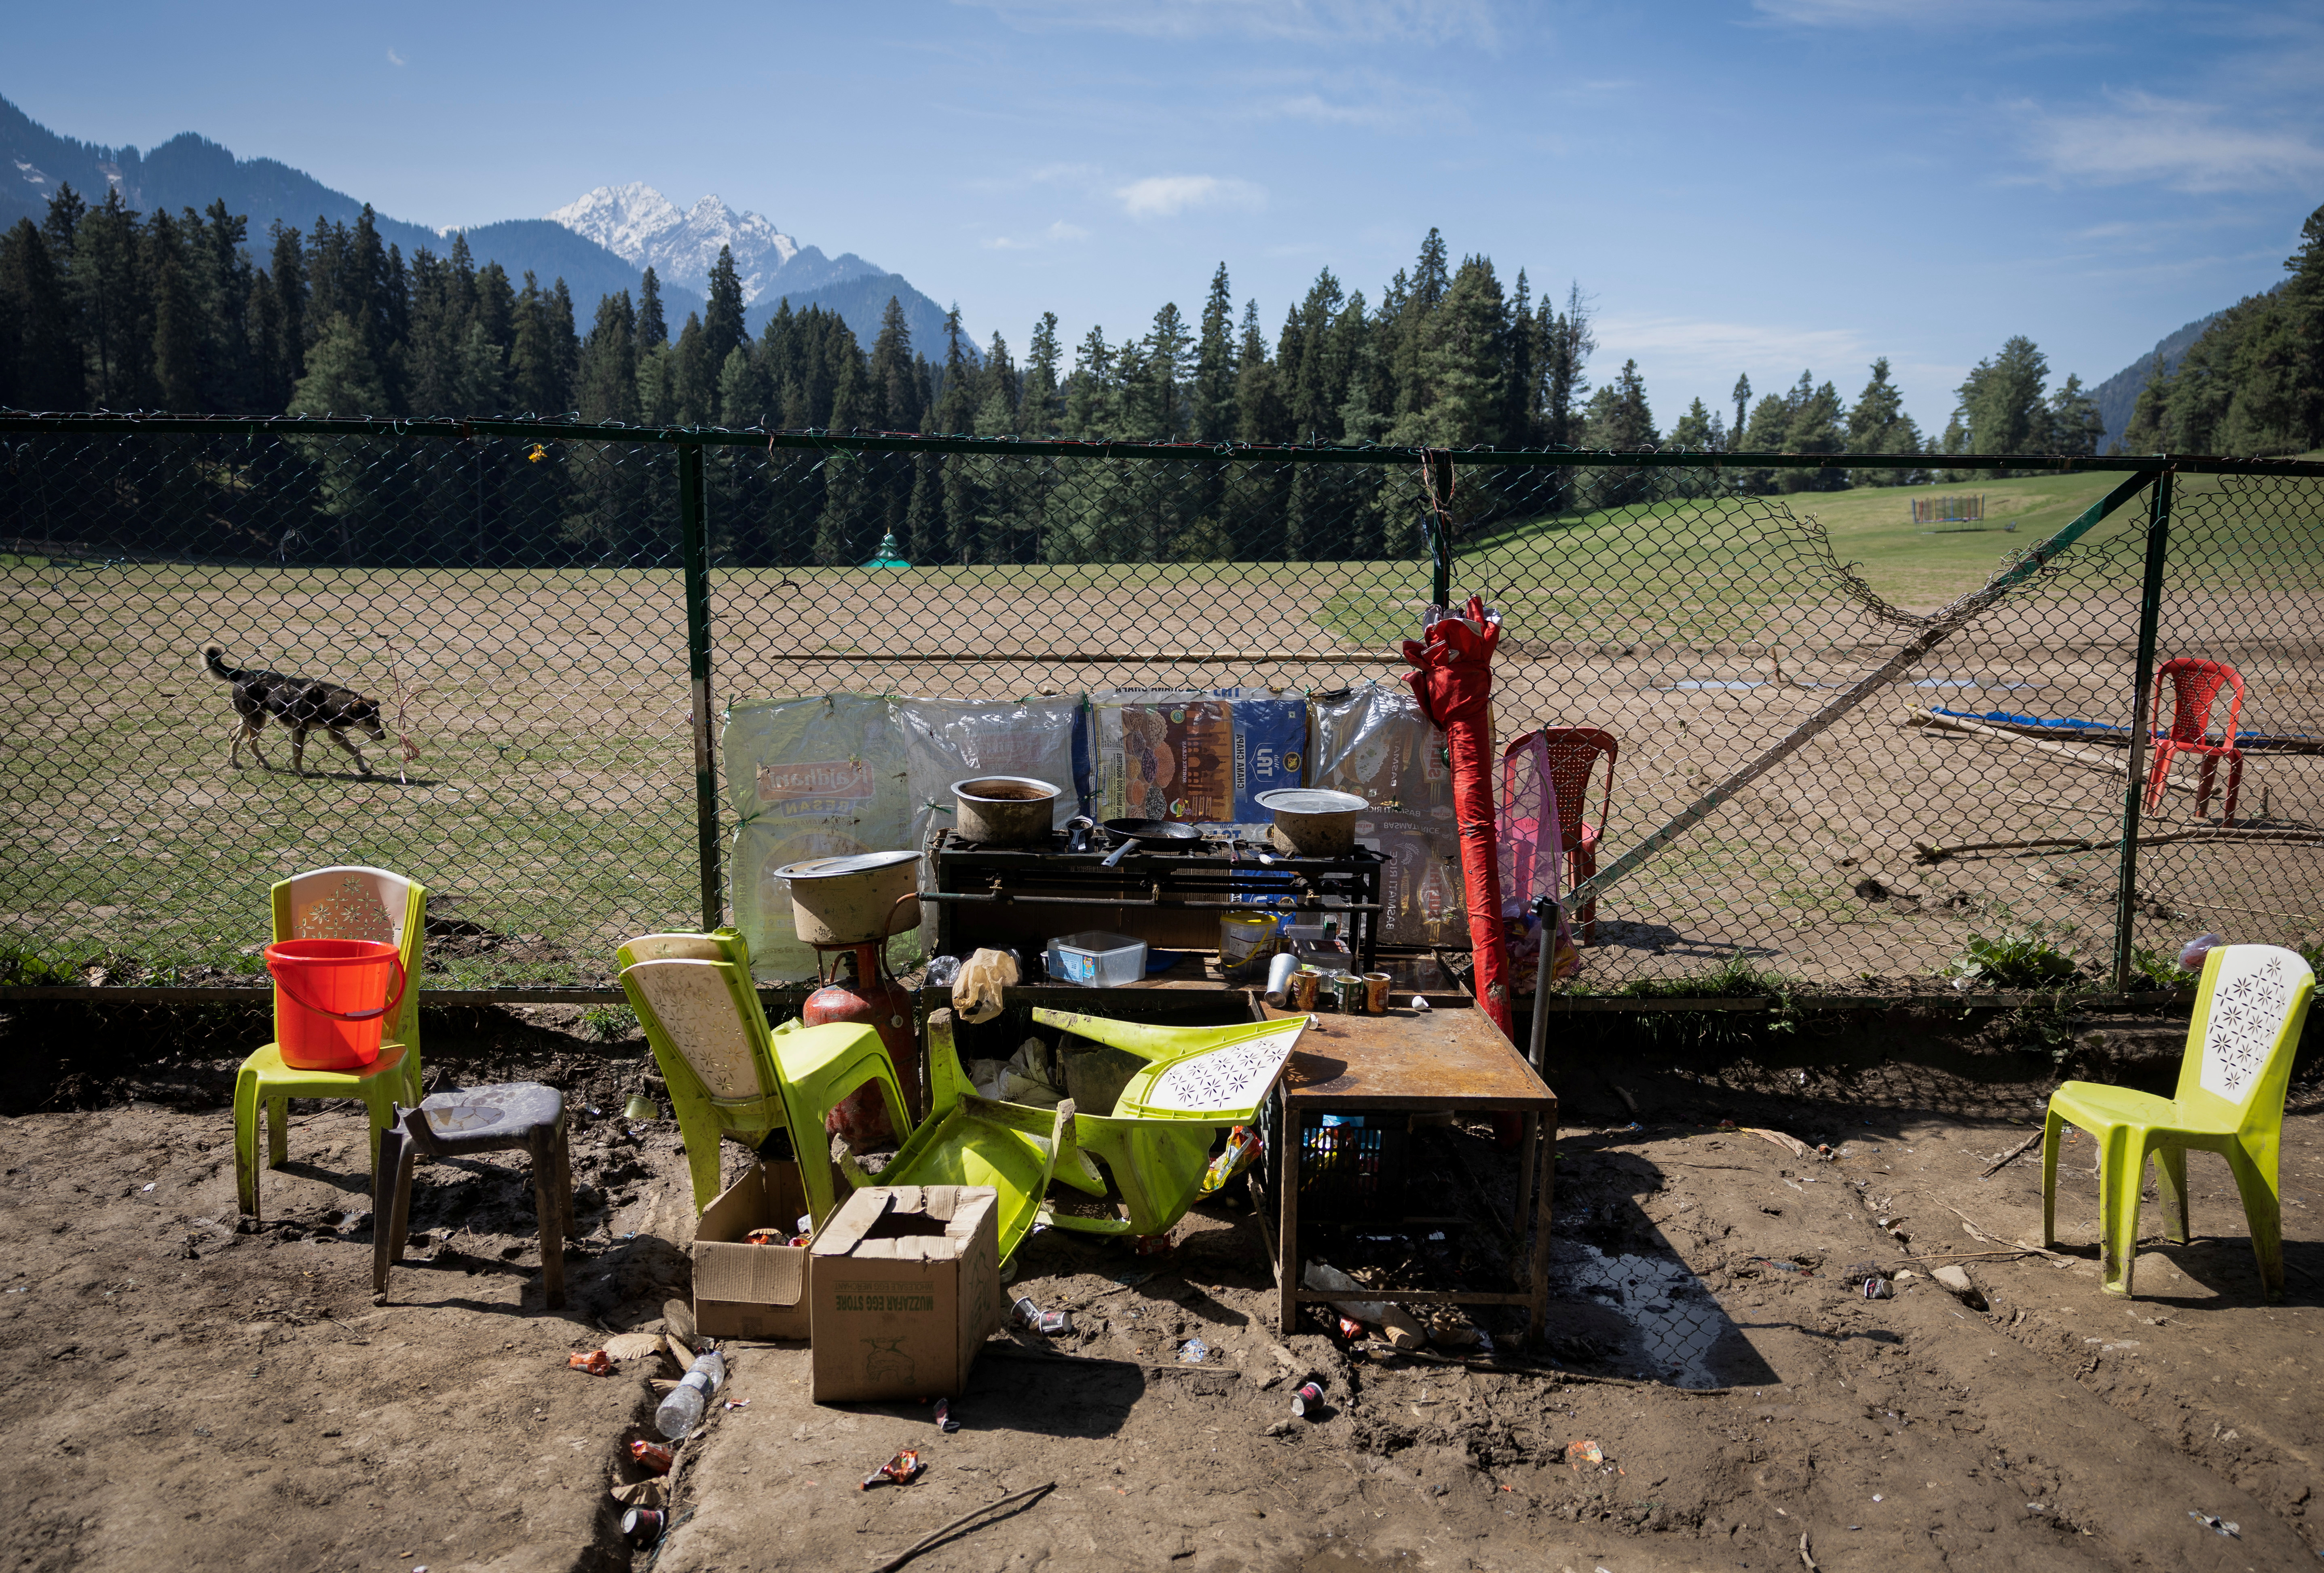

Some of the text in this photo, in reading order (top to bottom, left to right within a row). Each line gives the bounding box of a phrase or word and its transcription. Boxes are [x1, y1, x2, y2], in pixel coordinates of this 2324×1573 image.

[836, 1296, 934, 1311] MUZZAFAR EGG STORE
